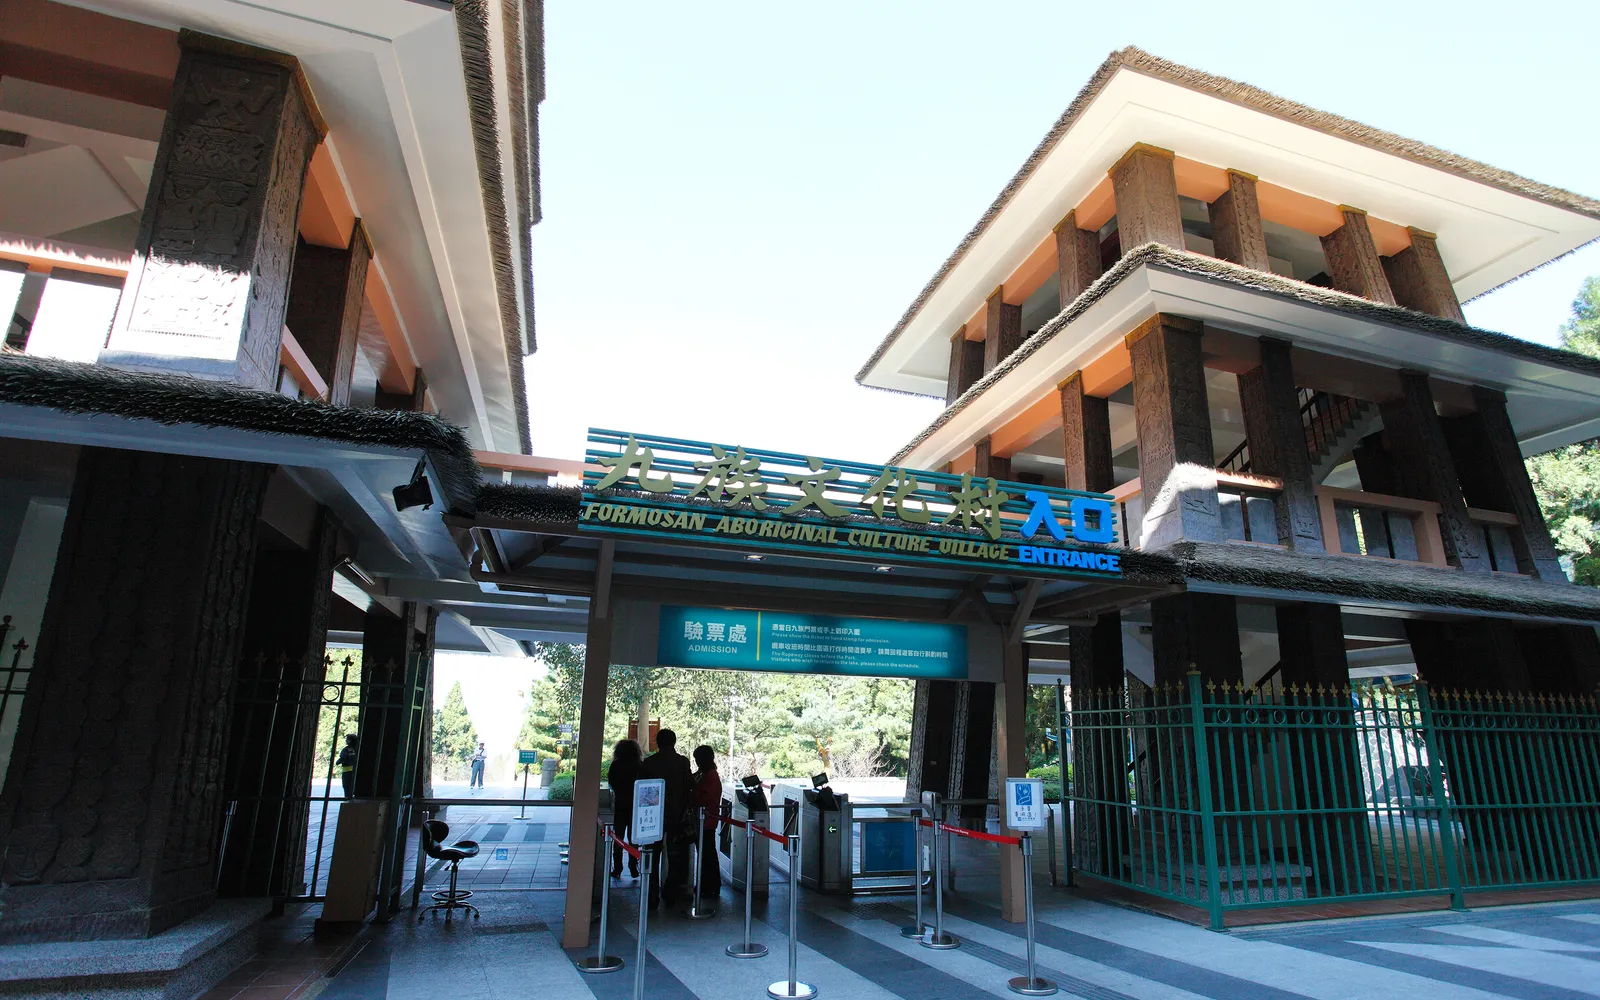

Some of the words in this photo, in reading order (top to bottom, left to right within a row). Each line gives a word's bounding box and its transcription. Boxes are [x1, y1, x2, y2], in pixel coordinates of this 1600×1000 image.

[595, 434, 1009, 540] 九族文化村
[1020, 490, 1114, 543] 入口
[583, 502, 707, 531] FORMOSAN
[714, 516, 838, 544] ABORIGINAL
[847, 529, 932, 552] CULTURE
[939, 538, 1010, 560] VILLAGE
[1018, 546, 1121, 572] ENTRANCE
[684, 621, 747, 643] 驗票處
[688, 644, 738, 653] ADMISSION
